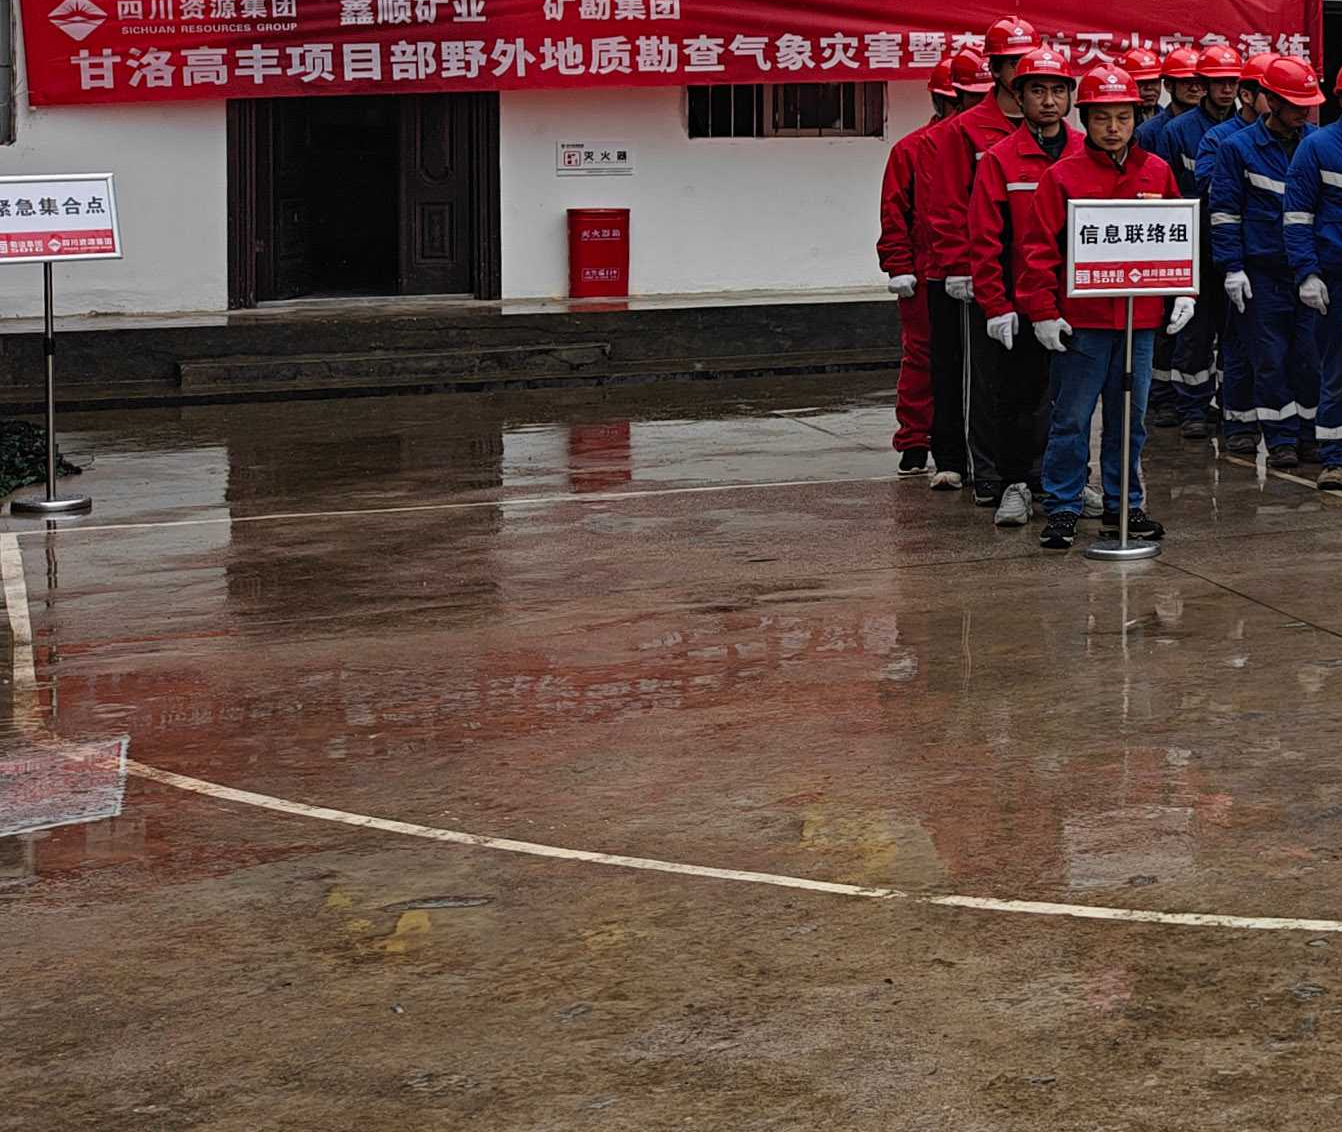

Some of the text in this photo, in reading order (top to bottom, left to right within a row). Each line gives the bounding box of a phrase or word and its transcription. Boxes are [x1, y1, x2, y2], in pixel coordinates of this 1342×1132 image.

[121, 23, 298, 35] SICHUAN RESOURCES GROUP
[0, 196, 105, 217] 紧急集合点
[1079, 223, 1189, 245] 信息联络组
